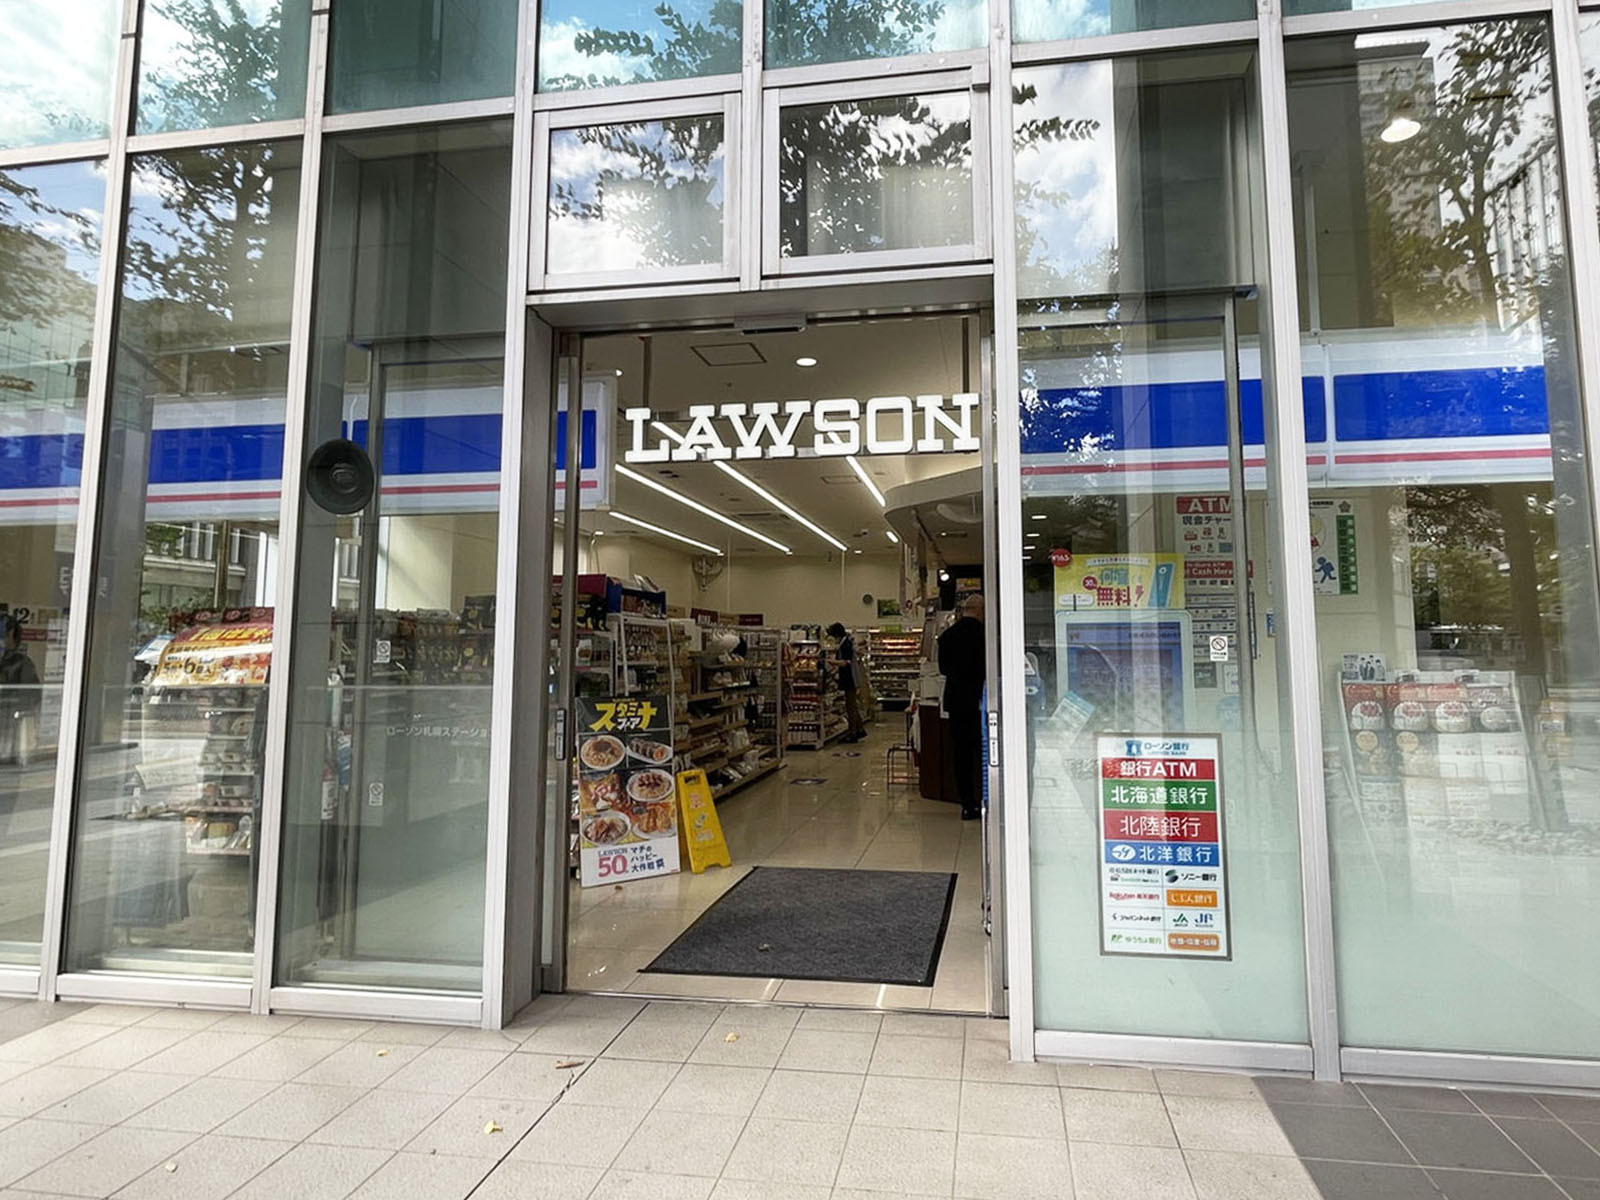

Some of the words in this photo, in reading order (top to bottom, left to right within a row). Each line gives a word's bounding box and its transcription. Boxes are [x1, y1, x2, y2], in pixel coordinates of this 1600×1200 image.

[625, 393, 980, 463] LAWSON
[1188, 497, 1232, 512] ATM
[589, 701, 658, 732] スタミナ
[1119, 760, 1197, 777] 銀行ATM
[1110, 785, 1208, 805] 北海道銀行
[1119, 815, 1202, 838] 北陸銀行
[1139, 845, 1212, 863] 北洋銀行
[598, 854, 628, 878] 50
[1181, 872, 1217, 882] ソニー銀行
